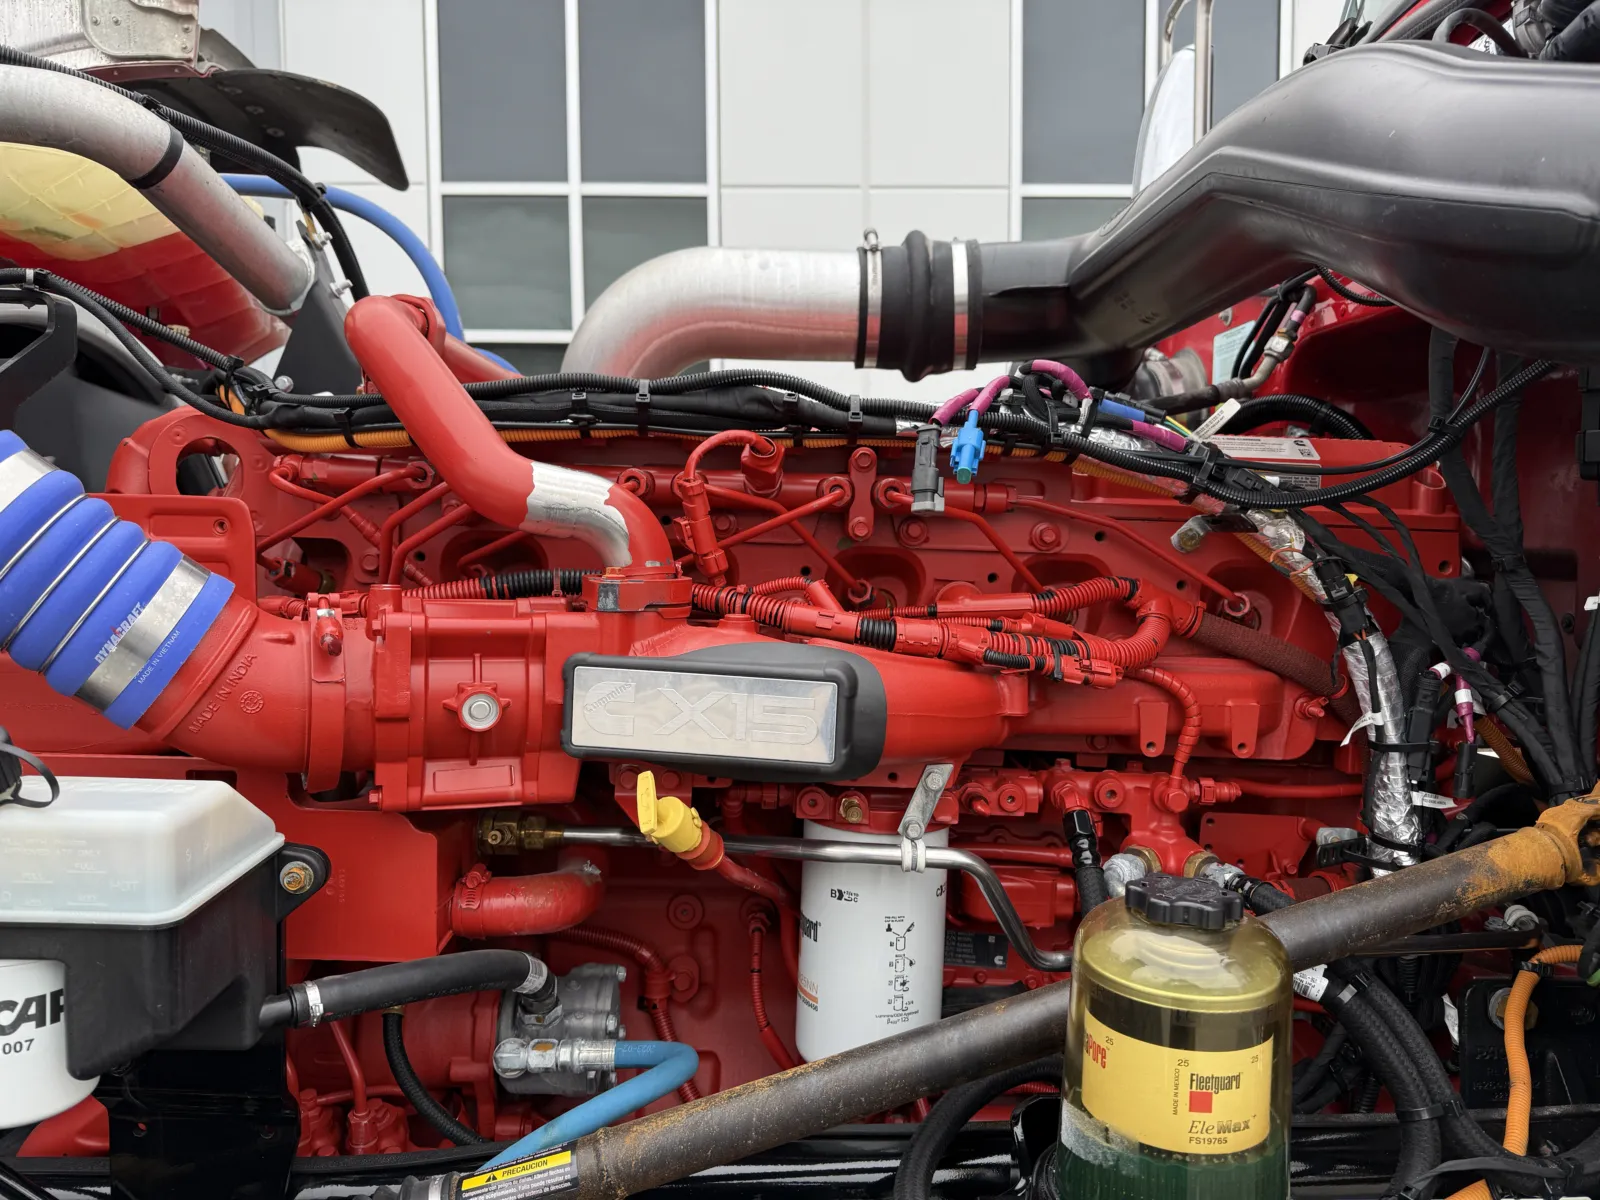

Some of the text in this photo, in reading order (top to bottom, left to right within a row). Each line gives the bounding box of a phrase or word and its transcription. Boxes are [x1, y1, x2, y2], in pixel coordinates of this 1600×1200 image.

[137, 630, 181, 685] MADE IN VIETNAM
[188, 654, 258, 734] MADE IN INDIA
[3, 1037, 35, 1055] 007
[1105, 1035, 1114, 1047] 25
[1177, 1058, 1190, 1068] 25
[1251, 1055, 1259, 1064] 25
[1189, 1072, 1241, 1095] Fleetguard
[1173, 1090, 1179, 1099] IN
[1188, 1137, 1228, 1145] FS19765
[501, 1159, 548, 1177] PRECAUCION
